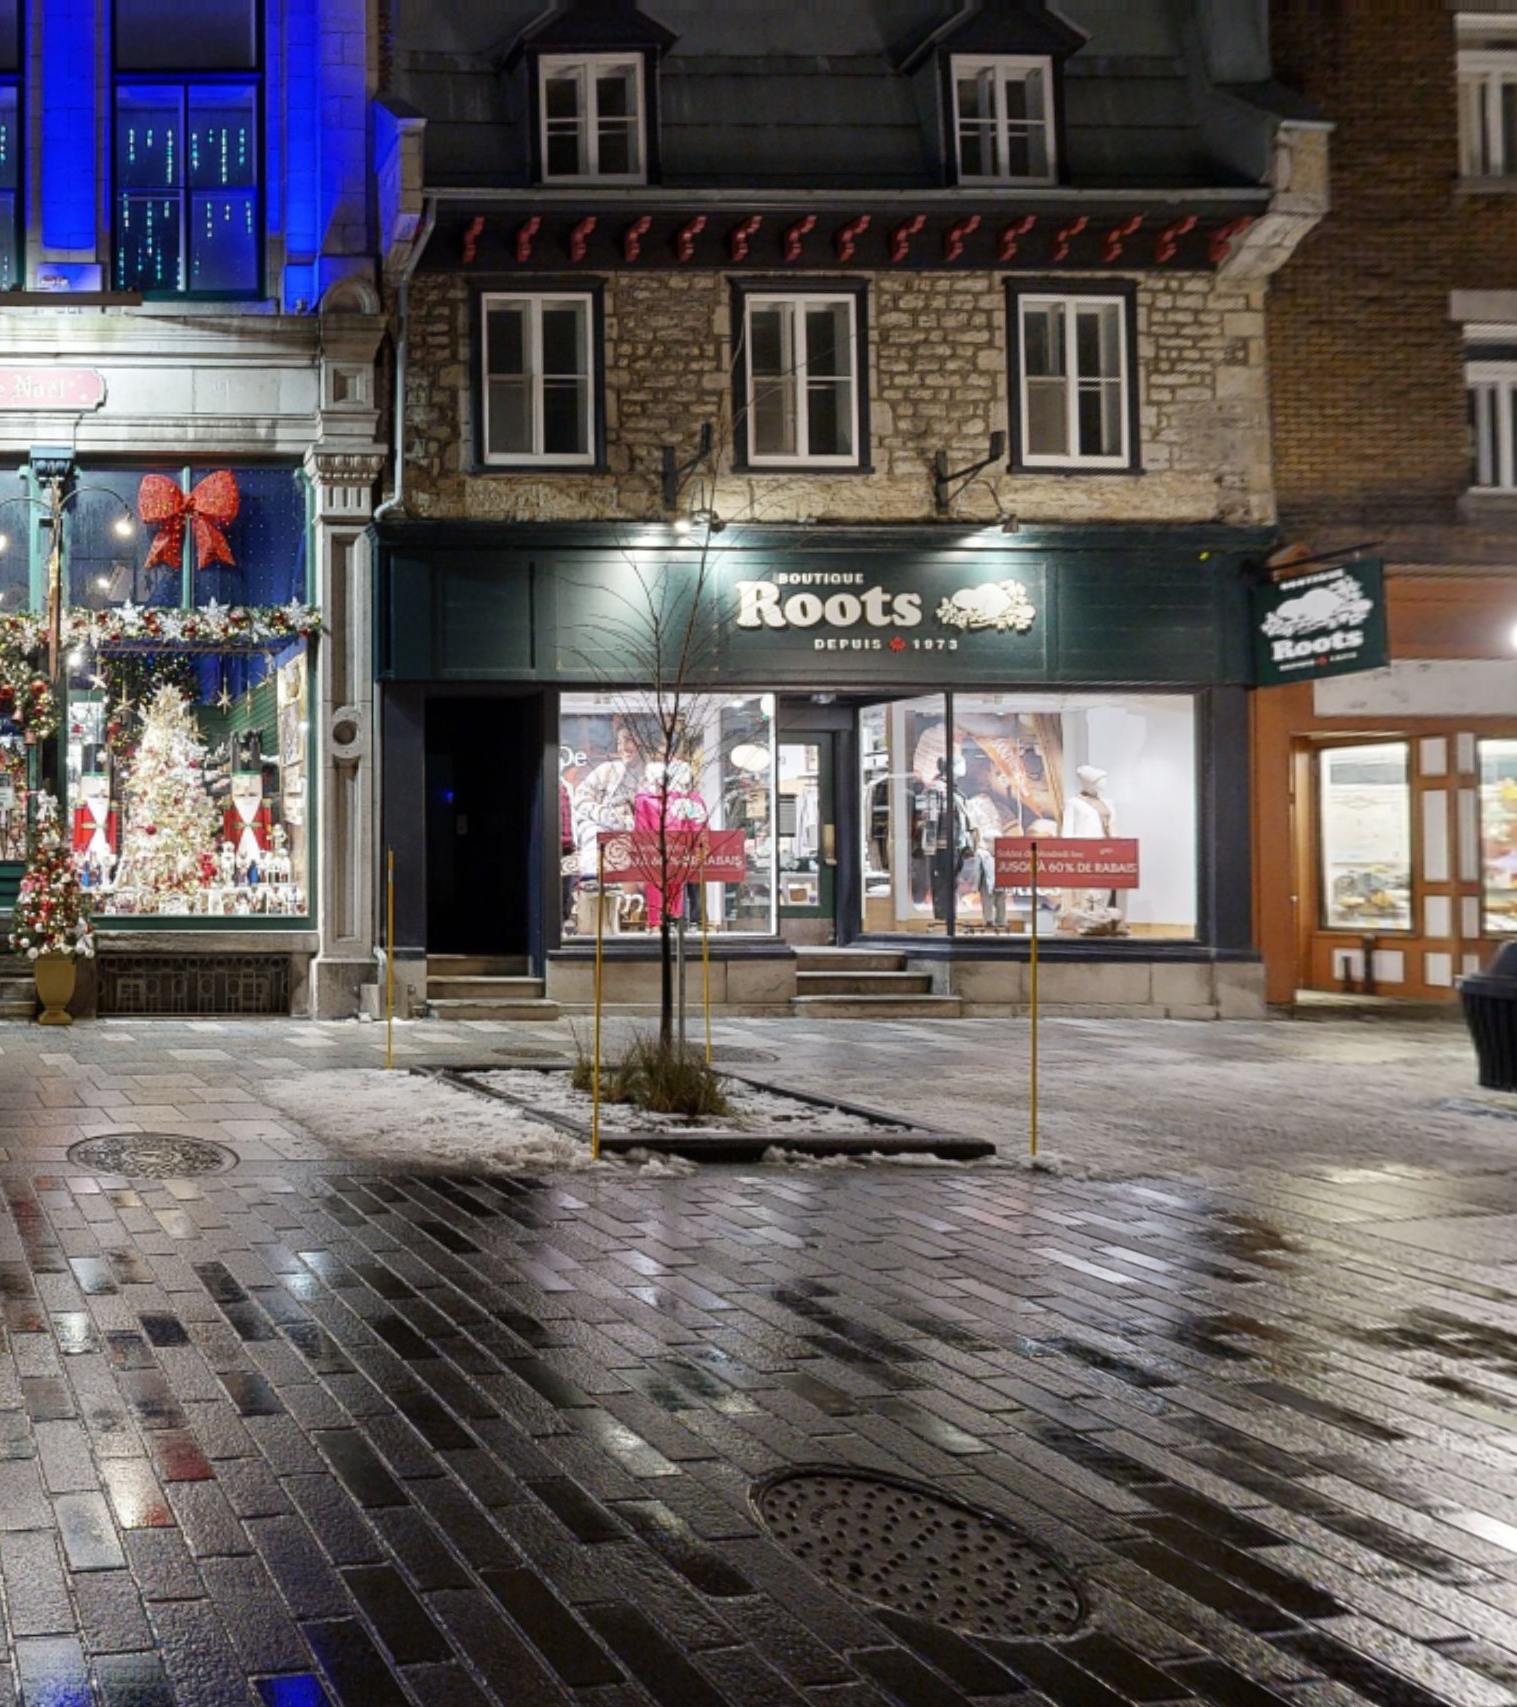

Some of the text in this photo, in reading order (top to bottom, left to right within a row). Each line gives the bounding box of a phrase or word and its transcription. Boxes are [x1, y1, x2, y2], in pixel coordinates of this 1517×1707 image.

[776, 572, 865, 585] BOUTIQUE
[735, 580, 923, 628] Roots
[813, 638, 958, 650] DEPUIS 1973
[1271, 630, 1364, 662] Roots
[1078, 863, 1092, 873] DE
[1095, 863, 1138, 874] RABAIS
